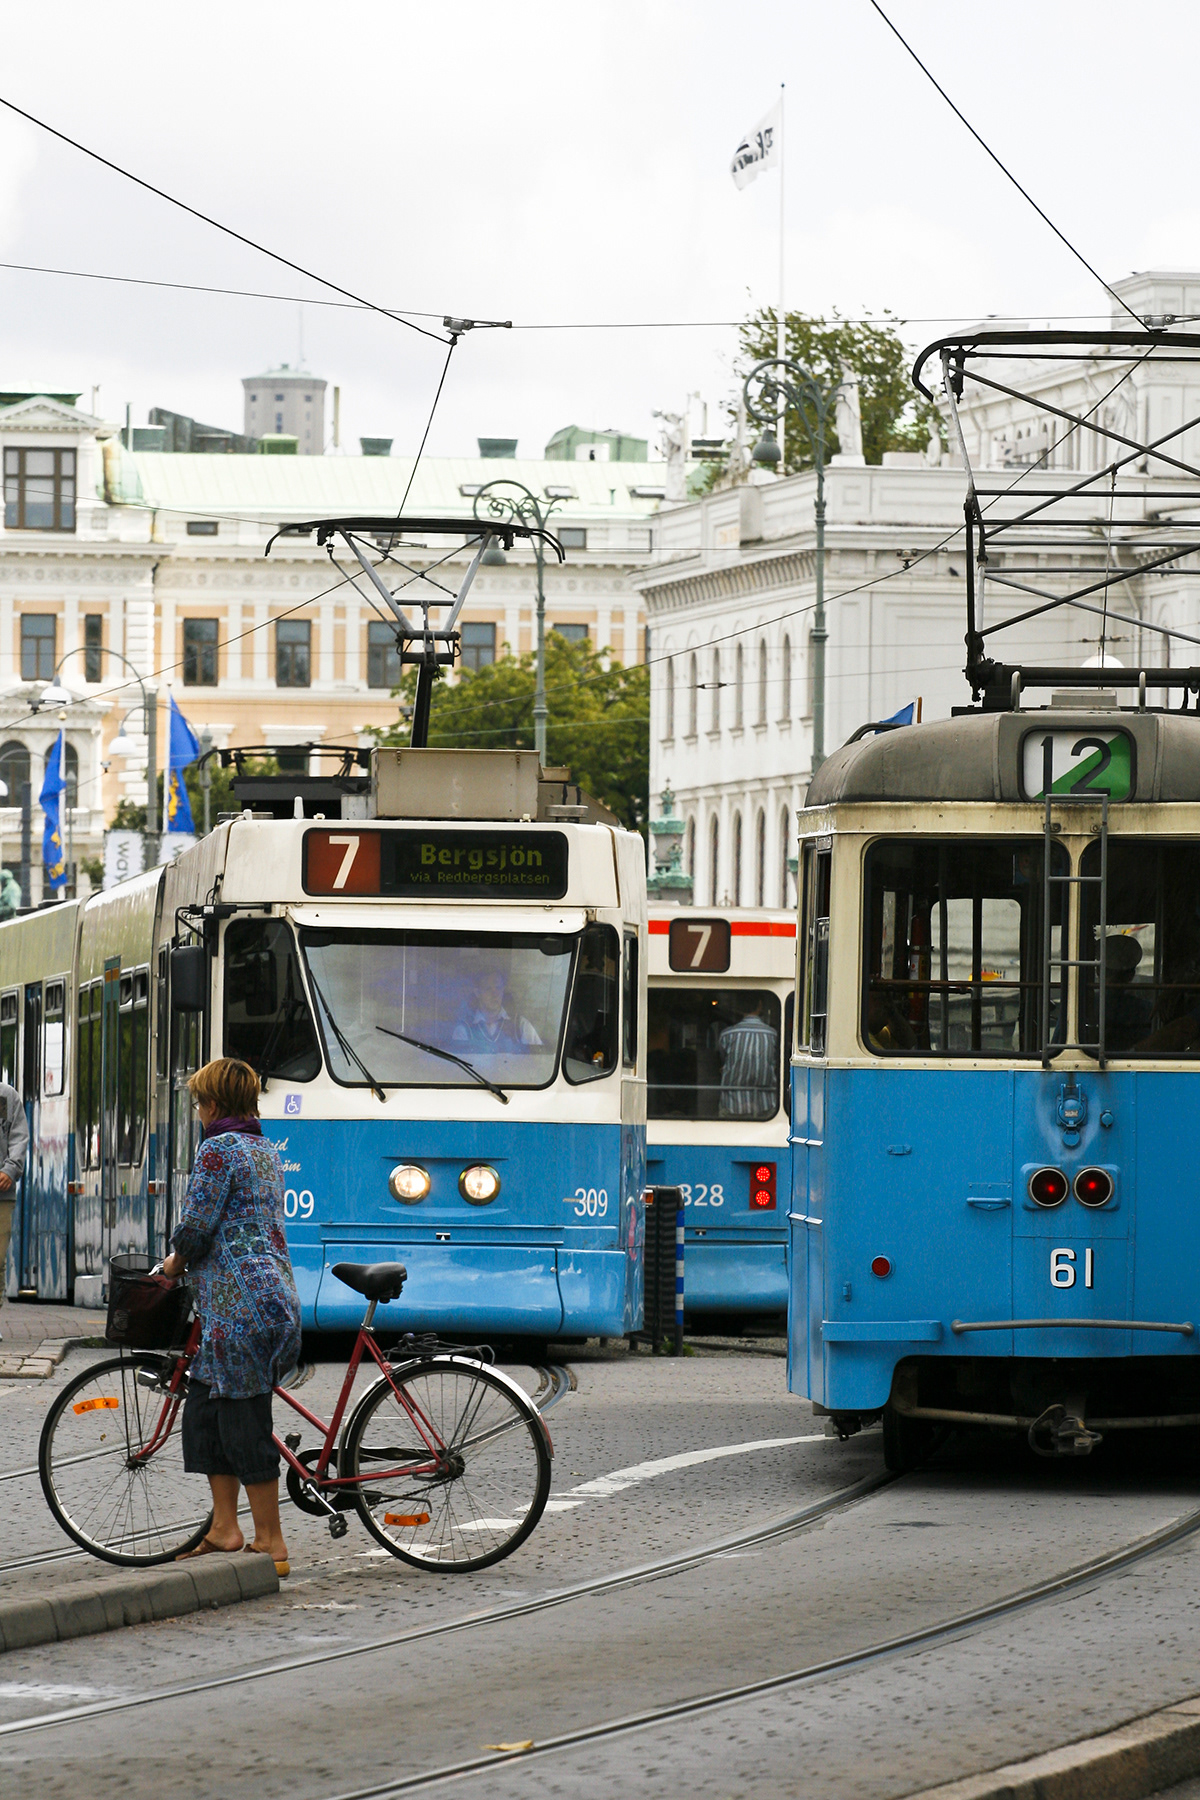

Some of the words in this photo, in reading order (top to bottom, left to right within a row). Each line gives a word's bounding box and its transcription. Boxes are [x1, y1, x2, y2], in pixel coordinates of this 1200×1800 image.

[1041, 736, 1111, 797] 12
[328, 835, 360, 889] 7
[421, 843, 543, 871] Bergsjön
[410, 871, 432, 883] via
[687, 924, 712, 968] 7
[284, 1189, 315, 1219] 09
[574, 1188, 608, 1217] 309
[1050, 1247, 1095, 1289] 61
